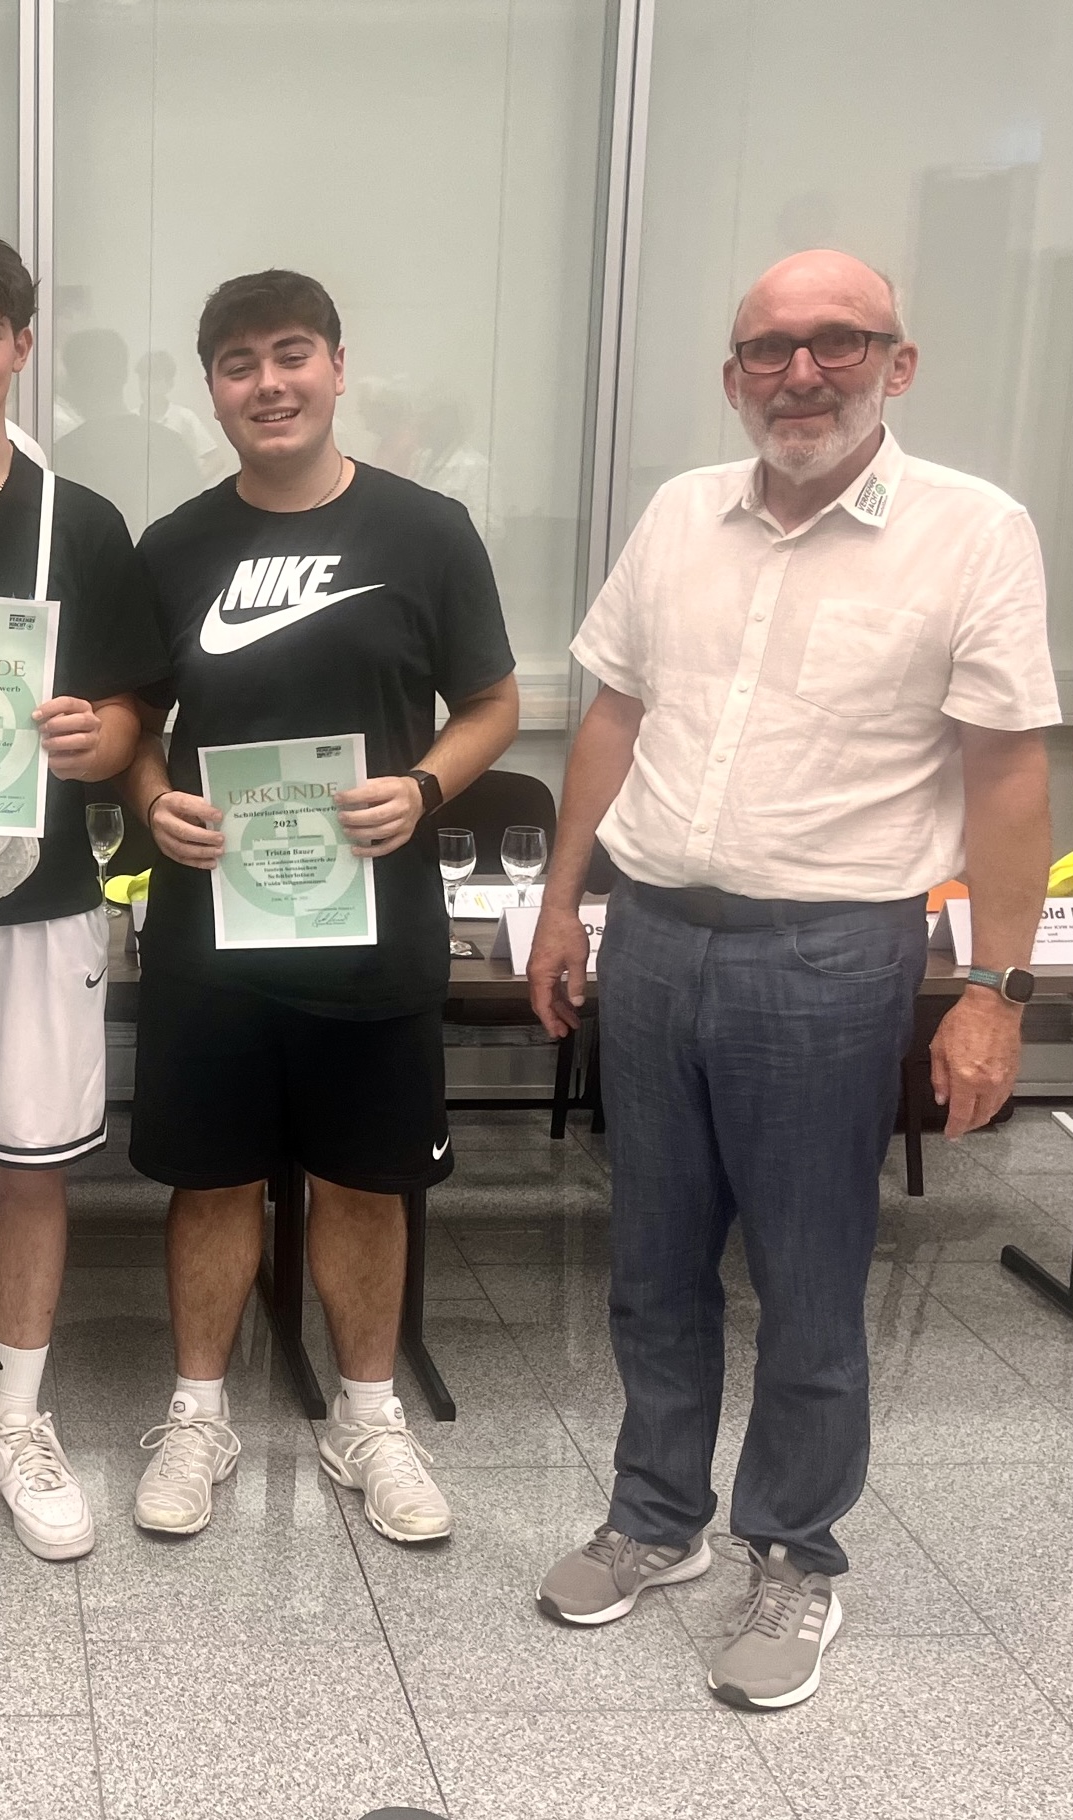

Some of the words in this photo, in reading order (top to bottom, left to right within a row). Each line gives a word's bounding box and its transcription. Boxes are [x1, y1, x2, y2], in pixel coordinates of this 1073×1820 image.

[222, 555, 342, 611] NIKE
[228, 781, 338, 806] URKUNDE
[273, 819, 298, 829] 2023
[265, 849, 291, 857] Tristan
[292, 848, 314, 856] Bauer
